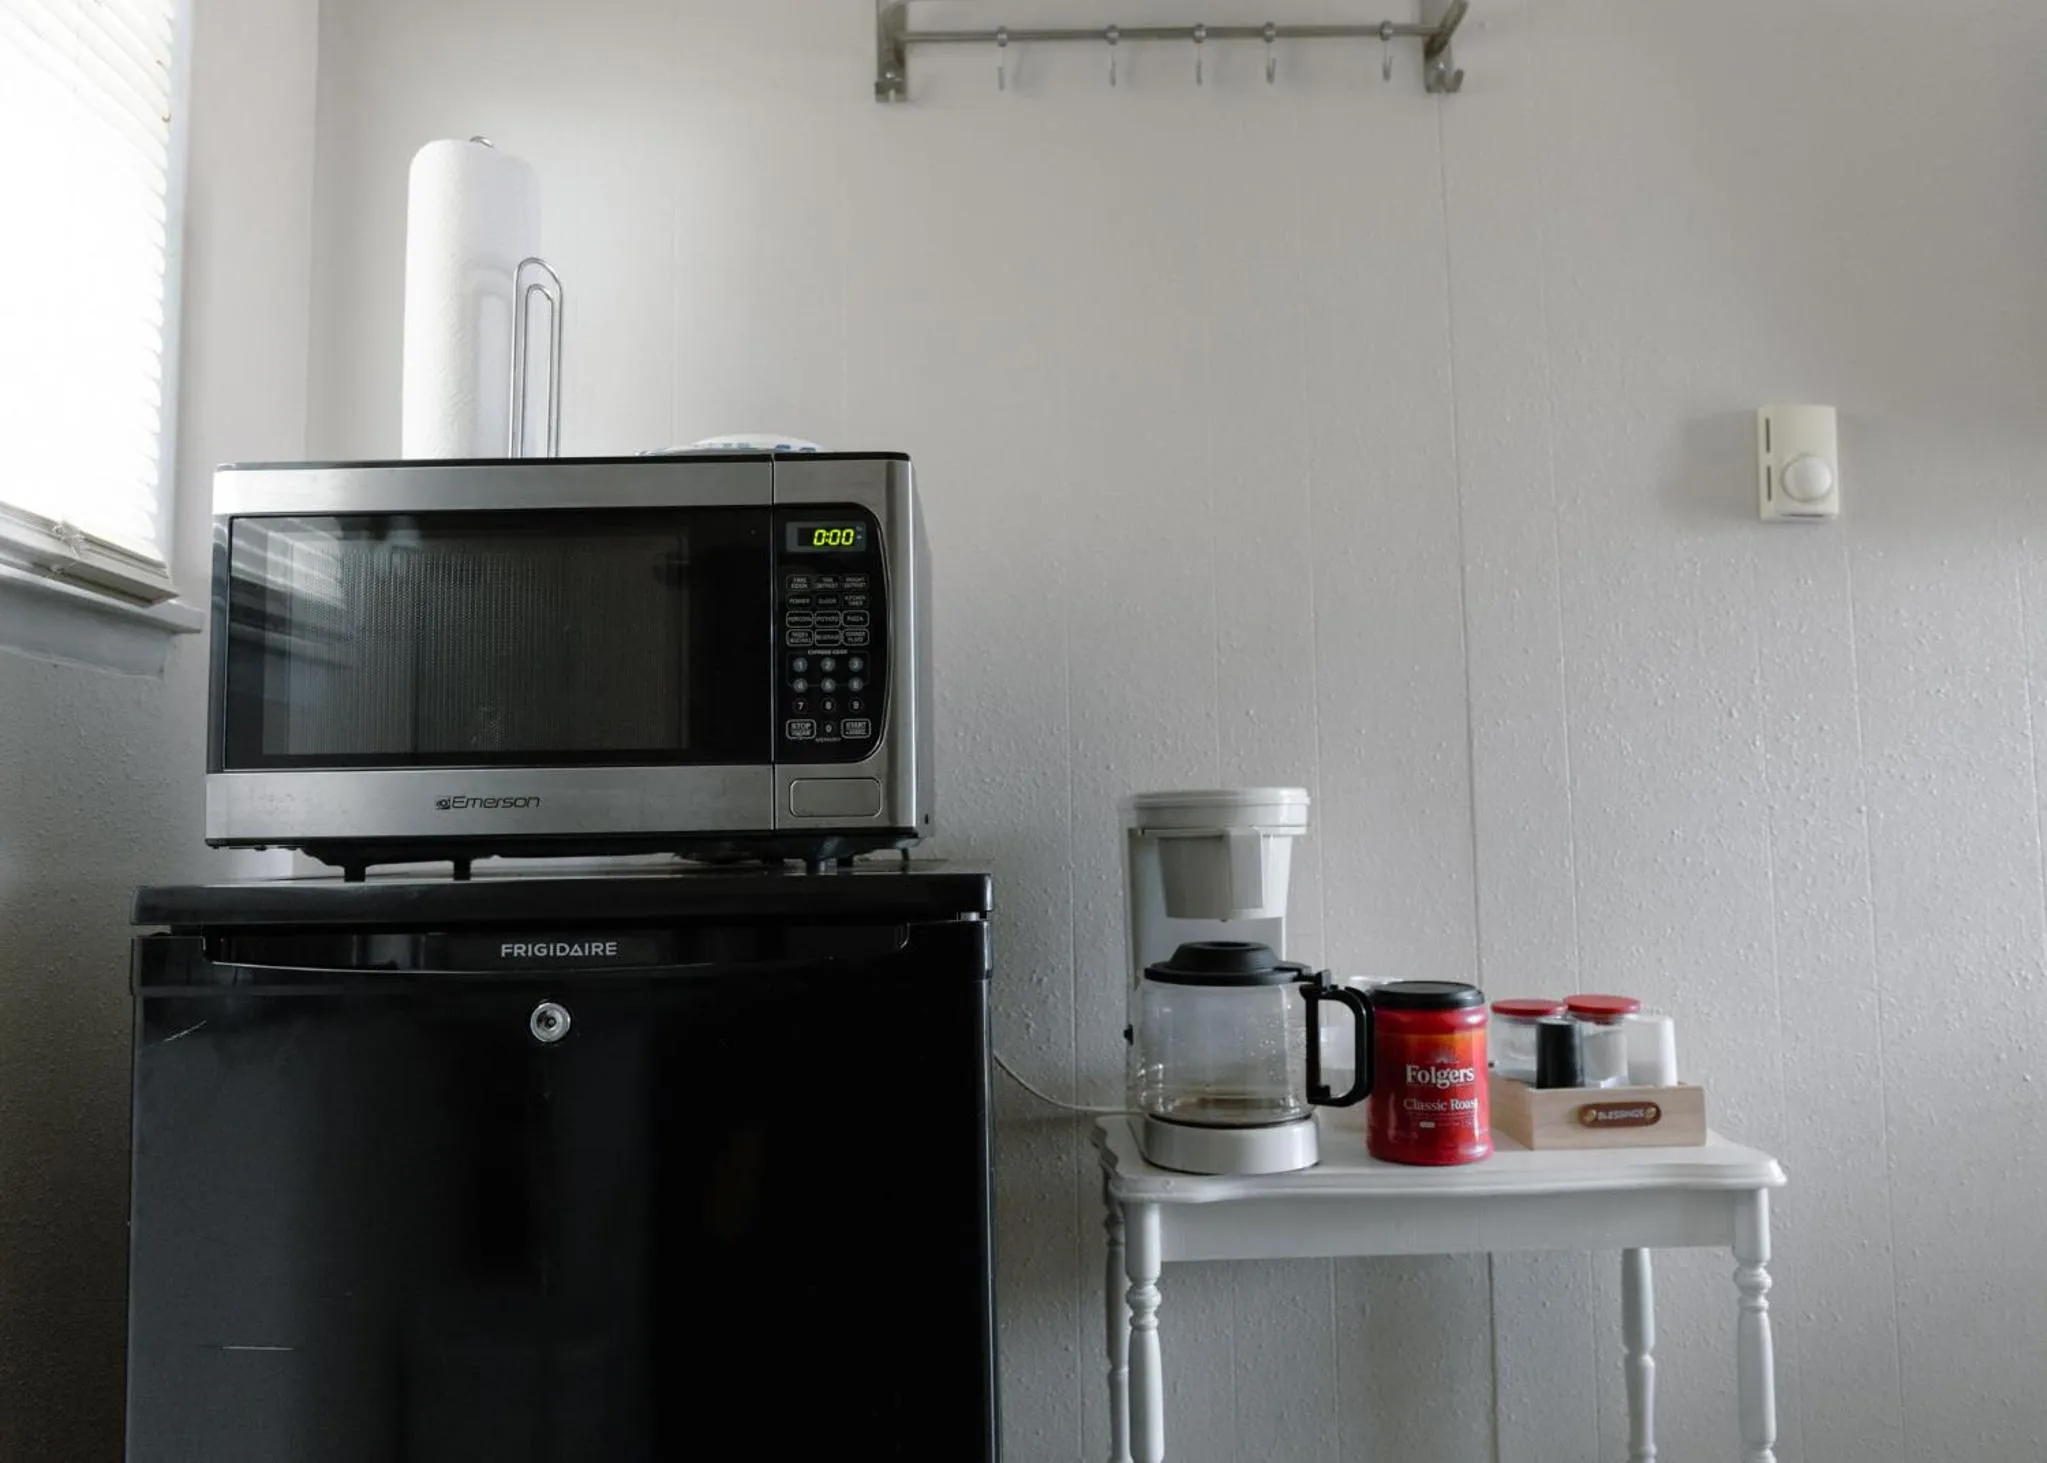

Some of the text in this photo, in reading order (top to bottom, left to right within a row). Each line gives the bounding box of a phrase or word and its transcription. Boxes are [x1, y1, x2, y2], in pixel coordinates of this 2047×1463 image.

[812, 528, 855, 546] 0:00
[451, 796, 541, 809] Emerson
[501, 942, 618, 958] FRIGIDAIRE
[1405, 1063, 1475, 1090] Folgers
[1402, 1098, 1448, 1112] Classic
